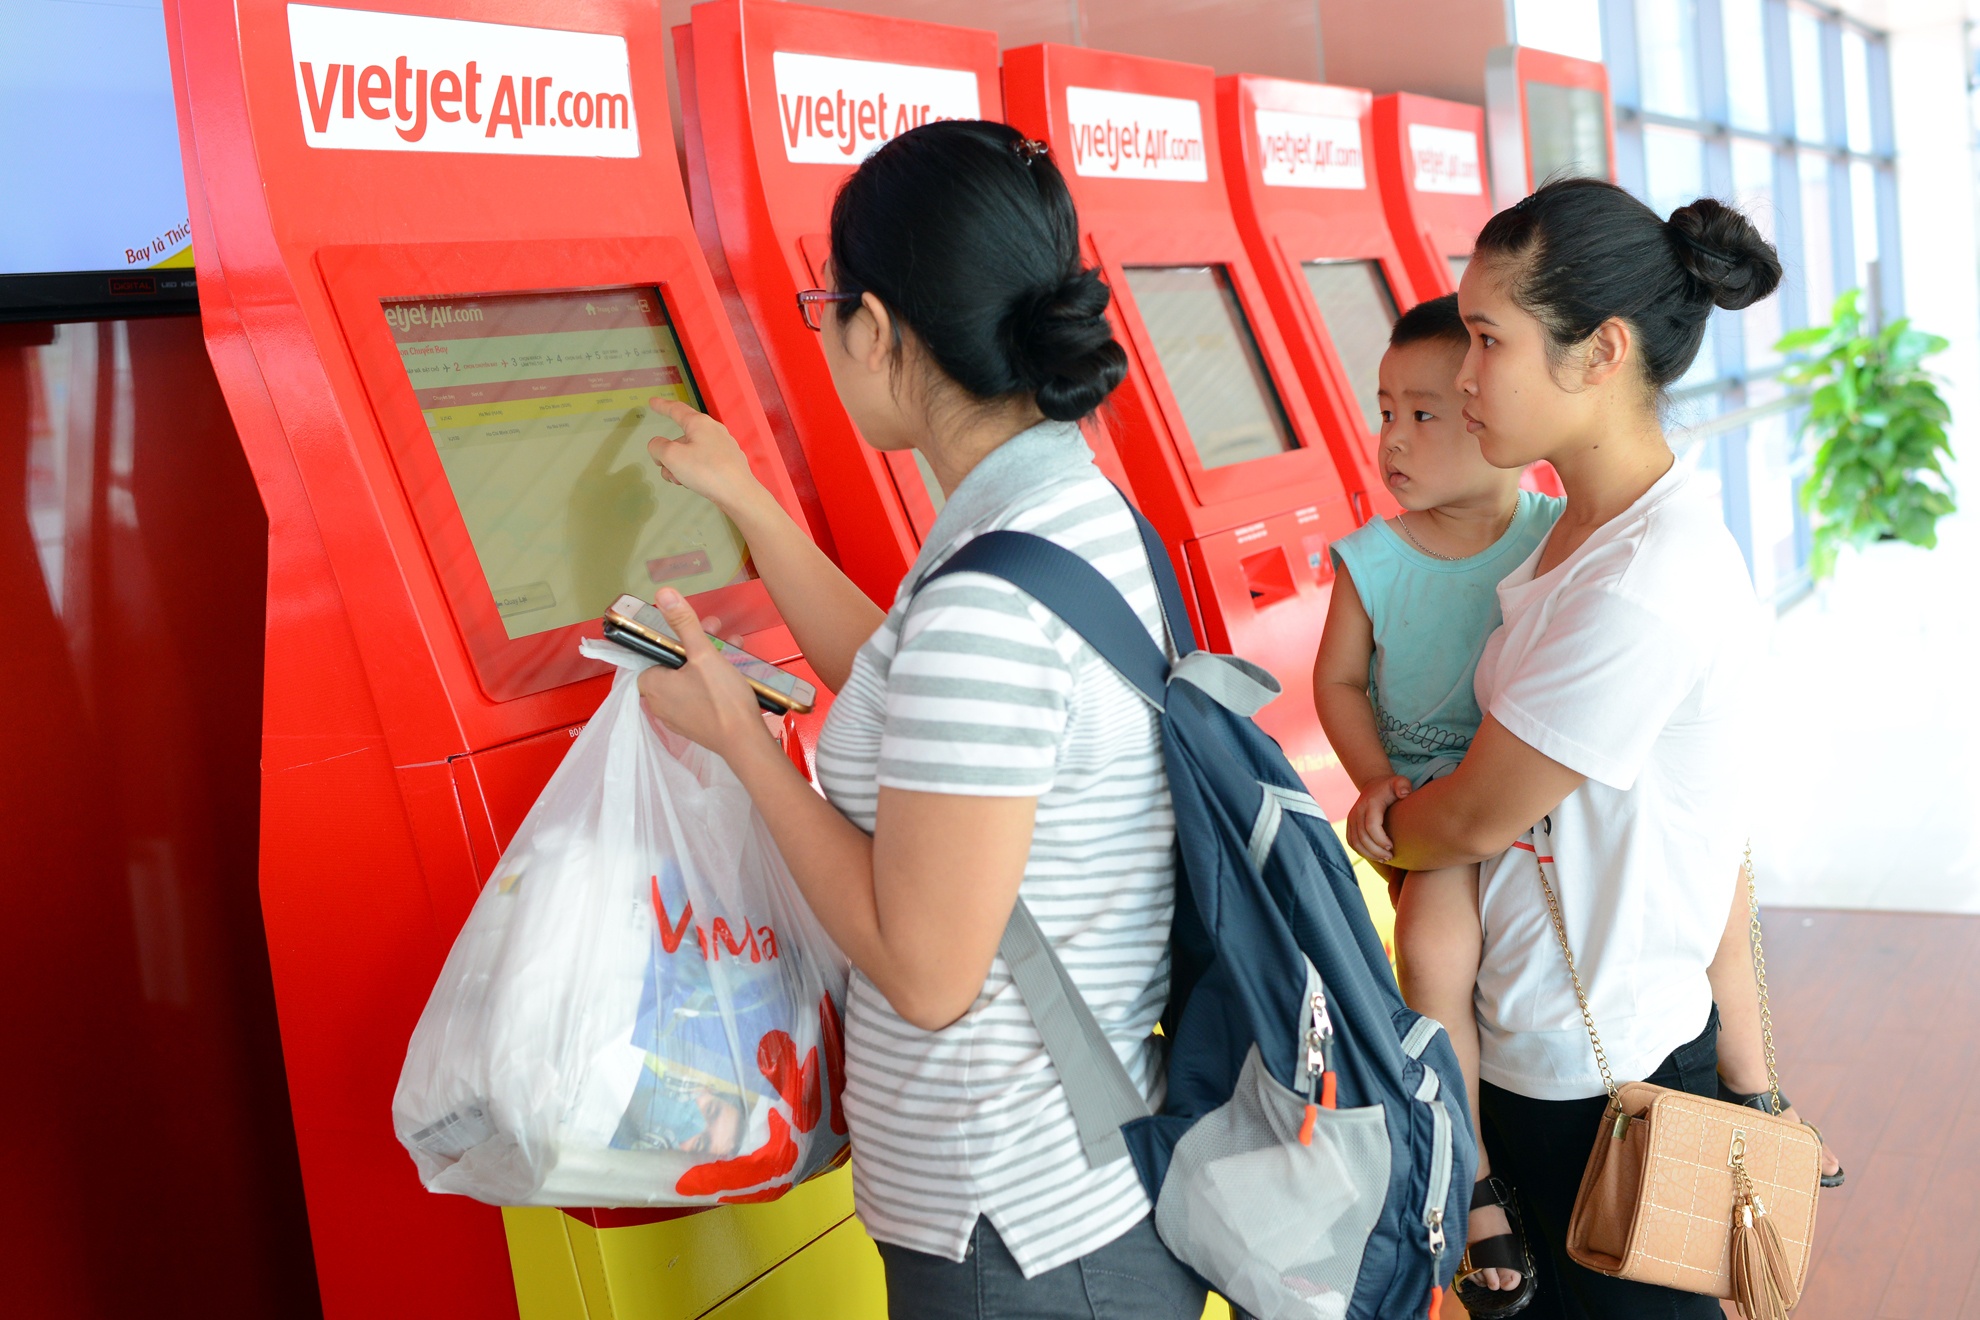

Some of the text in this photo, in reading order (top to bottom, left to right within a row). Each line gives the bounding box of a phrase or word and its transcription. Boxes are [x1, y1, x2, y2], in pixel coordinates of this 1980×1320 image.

[125, 218, 191, 265] Bay là Thíc
[453, 362, 461, 372] 2
[511, 357, 518, 367] 3
